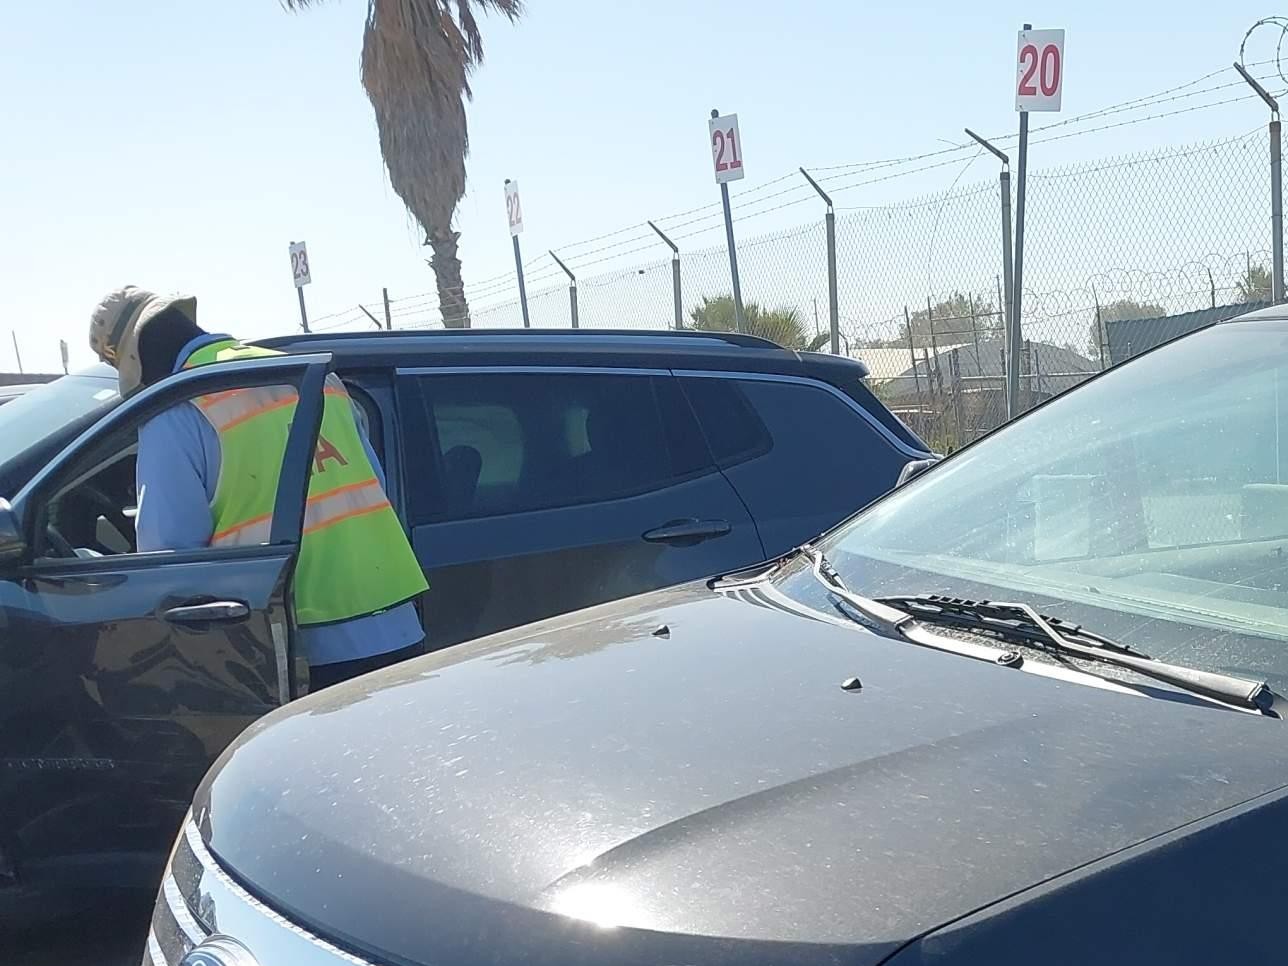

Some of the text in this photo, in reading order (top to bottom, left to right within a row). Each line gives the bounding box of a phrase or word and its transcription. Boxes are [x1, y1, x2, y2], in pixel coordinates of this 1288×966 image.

[1018, 44, 1060, 97] 20
[712, 127, 742, 172] 21
[506, 192, 521, 227] 22
[291, 250, 309, 279] 23
